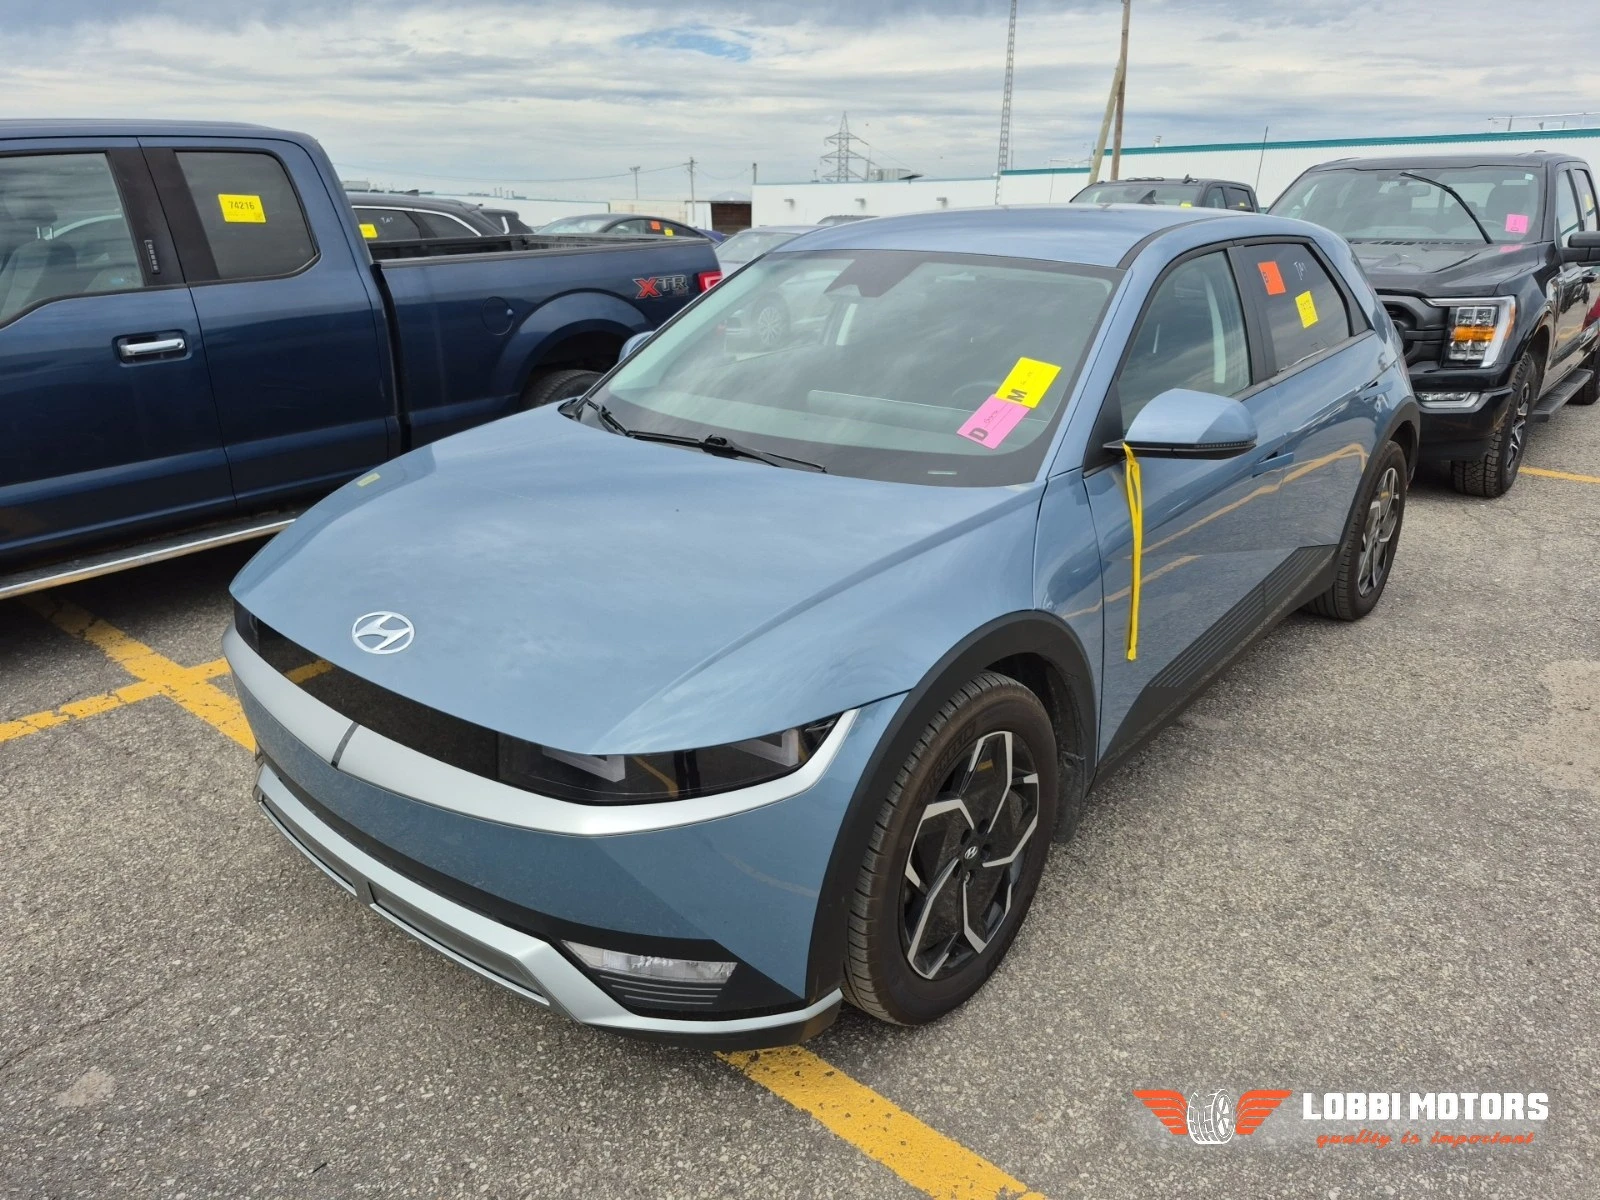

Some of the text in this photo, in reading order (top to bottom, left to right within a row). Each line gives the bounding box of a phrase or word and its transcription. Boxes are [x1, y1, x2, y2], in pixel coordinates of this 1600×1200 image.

[228, 200, 256, 210] 74216
[632, 274, 689, 299] XTR
[1006, 388, 1028, 403] M
[968, 427, 989, 441] D
